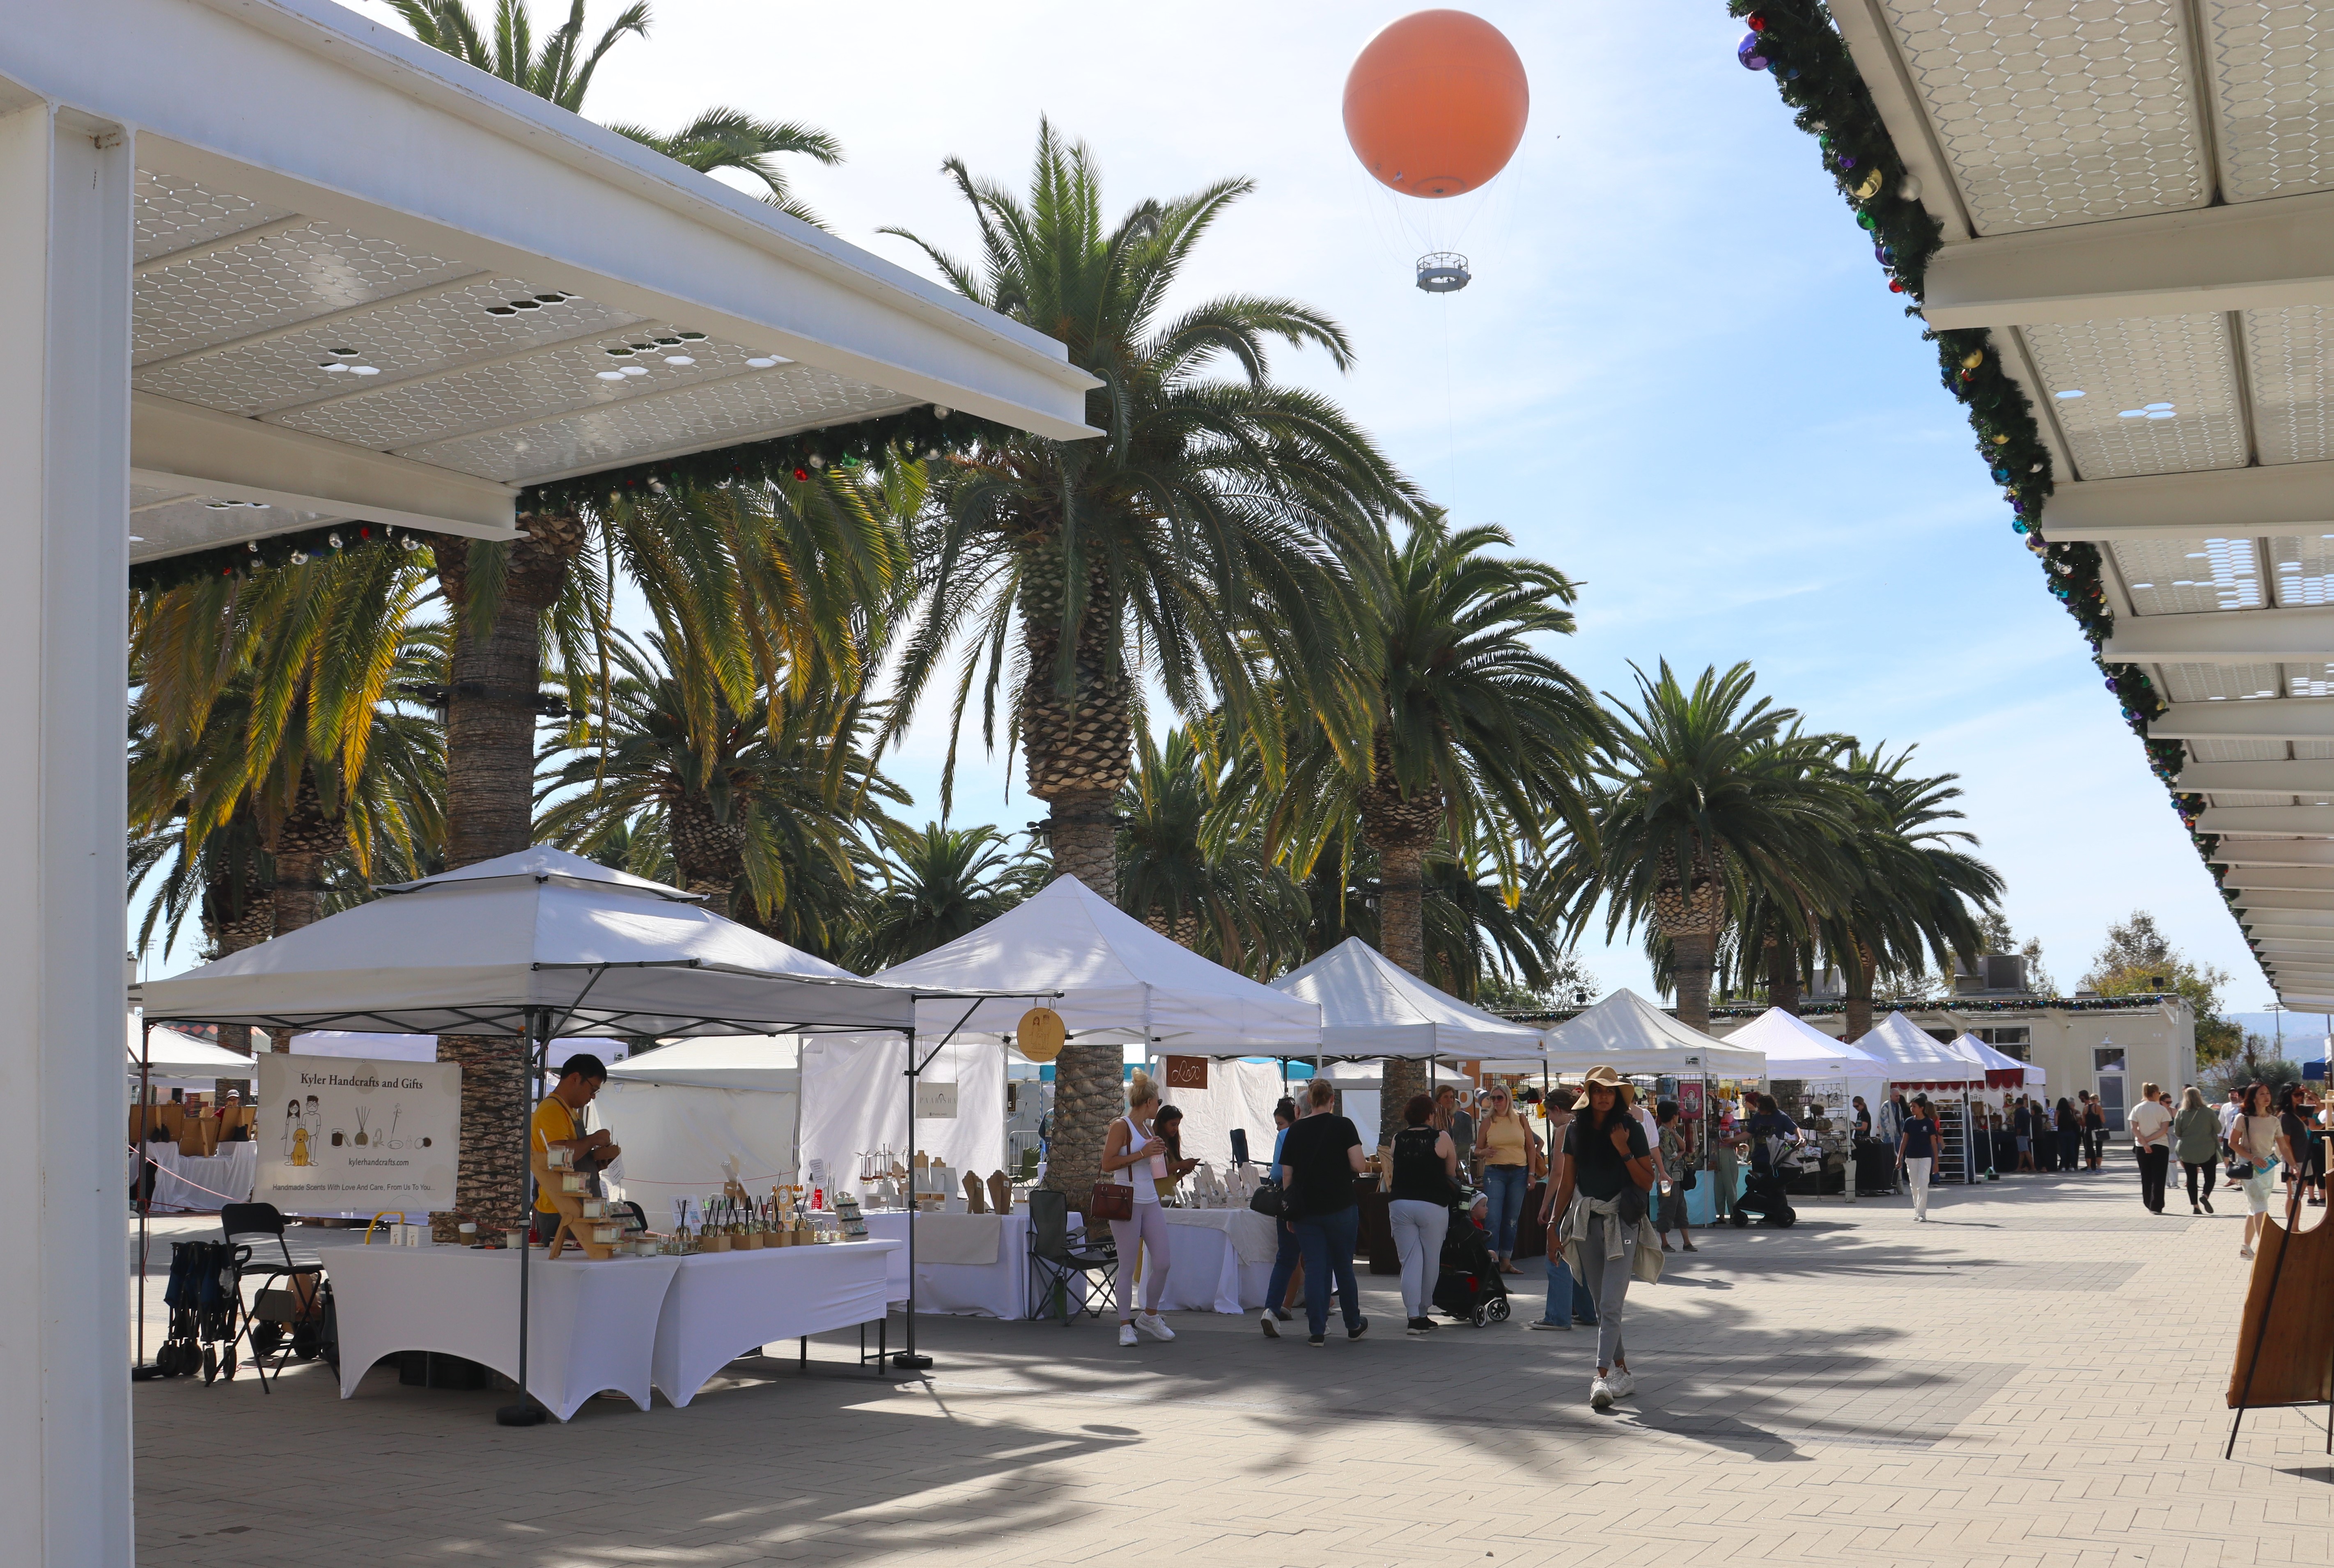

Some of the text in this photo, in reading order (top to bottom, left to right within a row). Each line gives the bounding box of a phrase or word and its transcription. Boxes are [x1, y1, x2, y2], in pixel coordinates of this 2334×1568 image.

[301, 1073, 423, 1089] Kyler Handcrafts and Gifts
[349, 1158, 409, 1167] kylerhandcrafts.com
